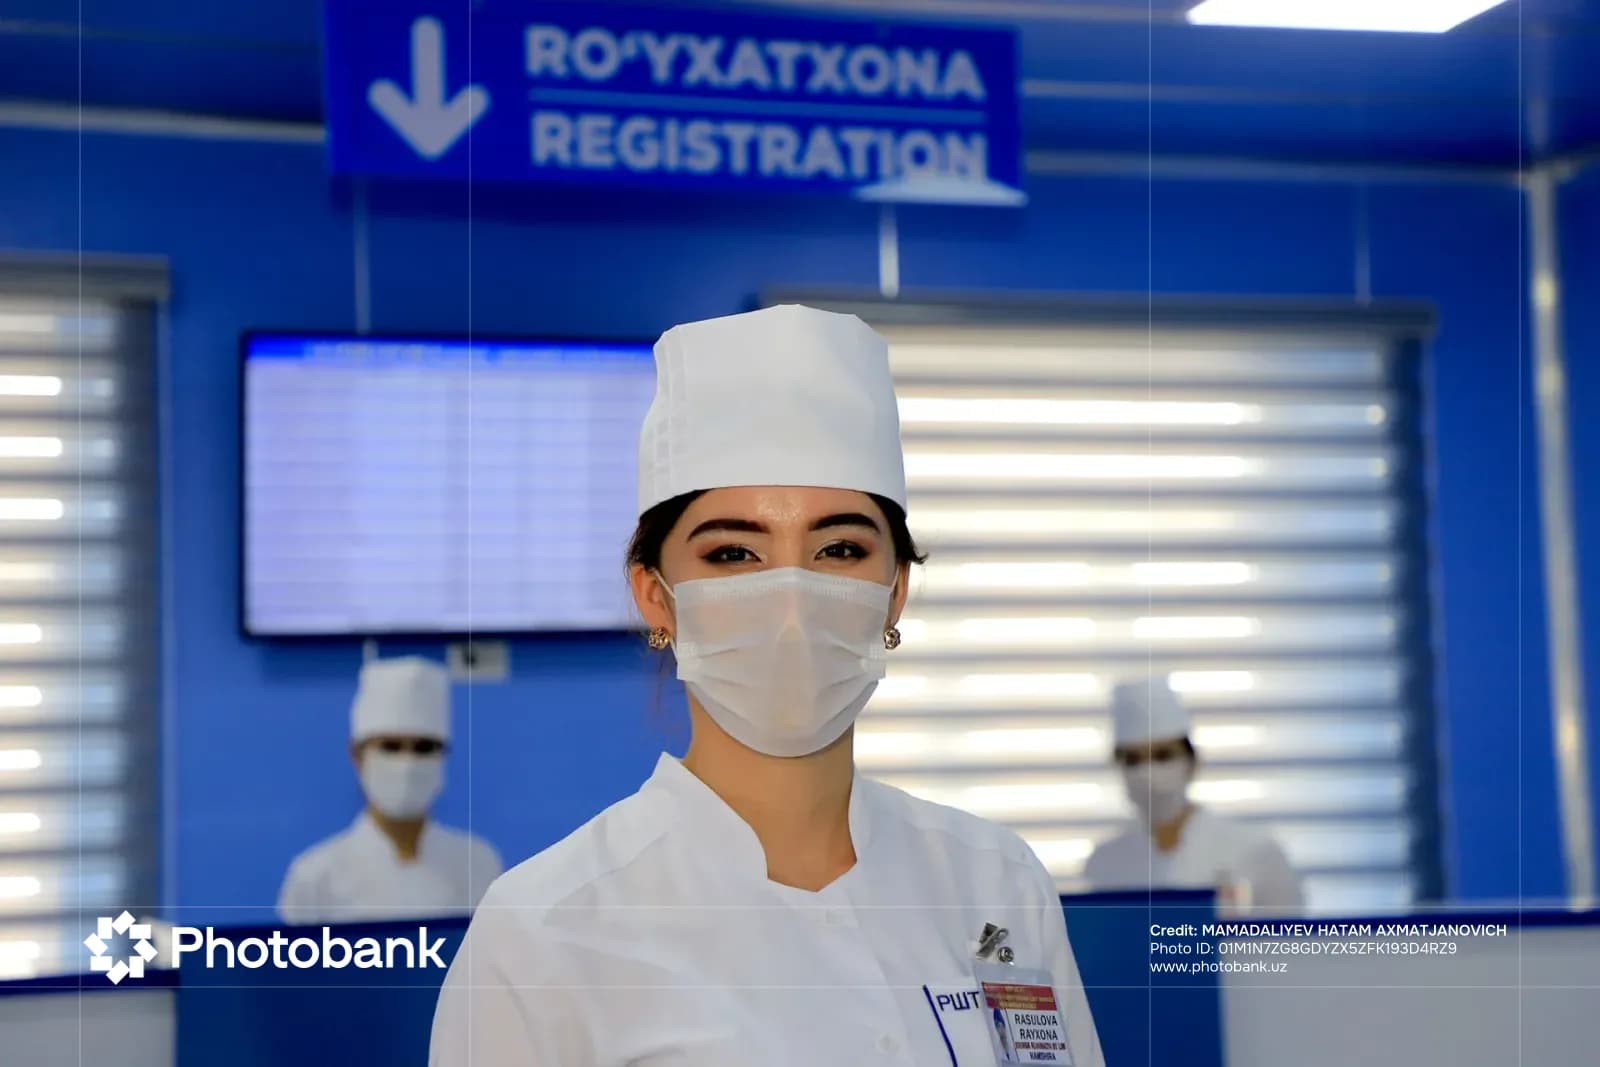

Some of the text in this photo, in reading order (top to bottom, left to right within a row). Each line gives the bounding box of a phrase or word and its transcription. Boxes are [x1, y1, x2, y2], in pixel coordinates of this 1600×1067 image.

[531, 112, 988, 182] REGISTRATION
[1014, 1013, 1058, 1026] RASULOVA
[1019, 1028, 1058, 1041] RAYXONA
